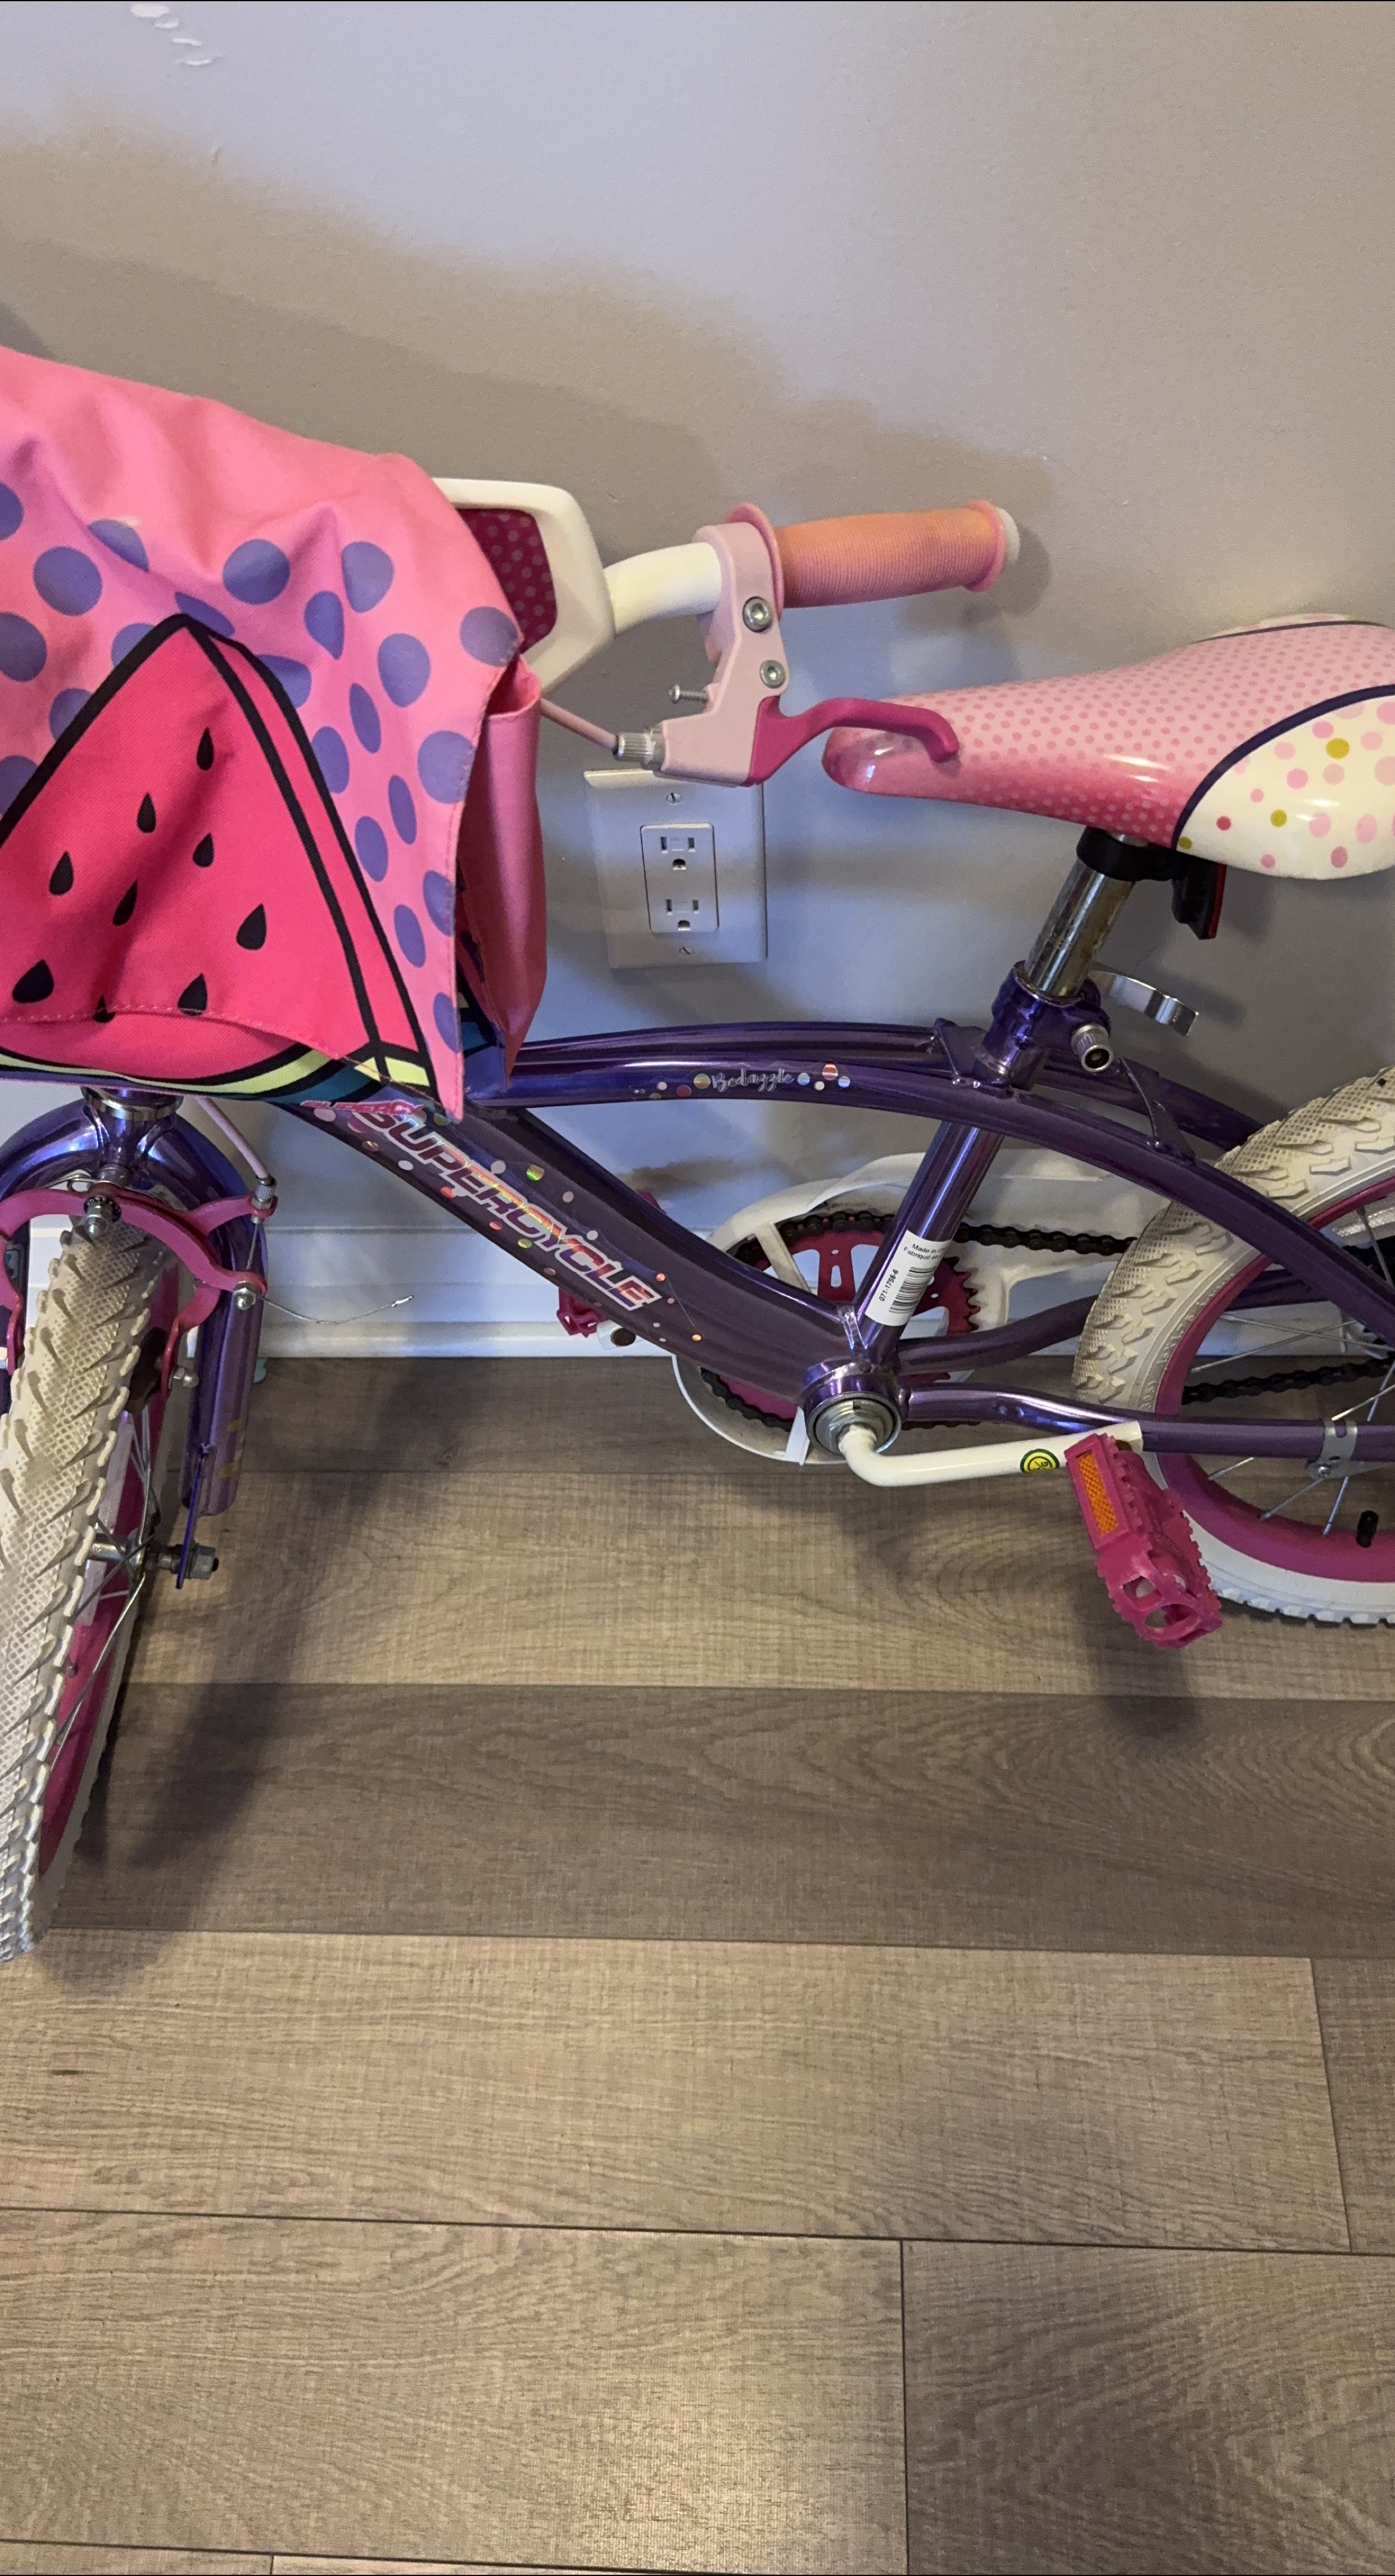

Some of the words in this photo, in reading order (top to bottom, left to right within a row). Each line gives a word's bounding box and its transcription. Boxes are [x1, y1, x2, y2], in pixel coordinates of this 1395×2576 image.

[710, 1068, 795, 1092] Bedazzle
[353, 1111, 662, 1311] SUPERCYCLE
[912, 1243, 930, 1253] Made
[879, 1268, 898, 1302] 071-1756-6
